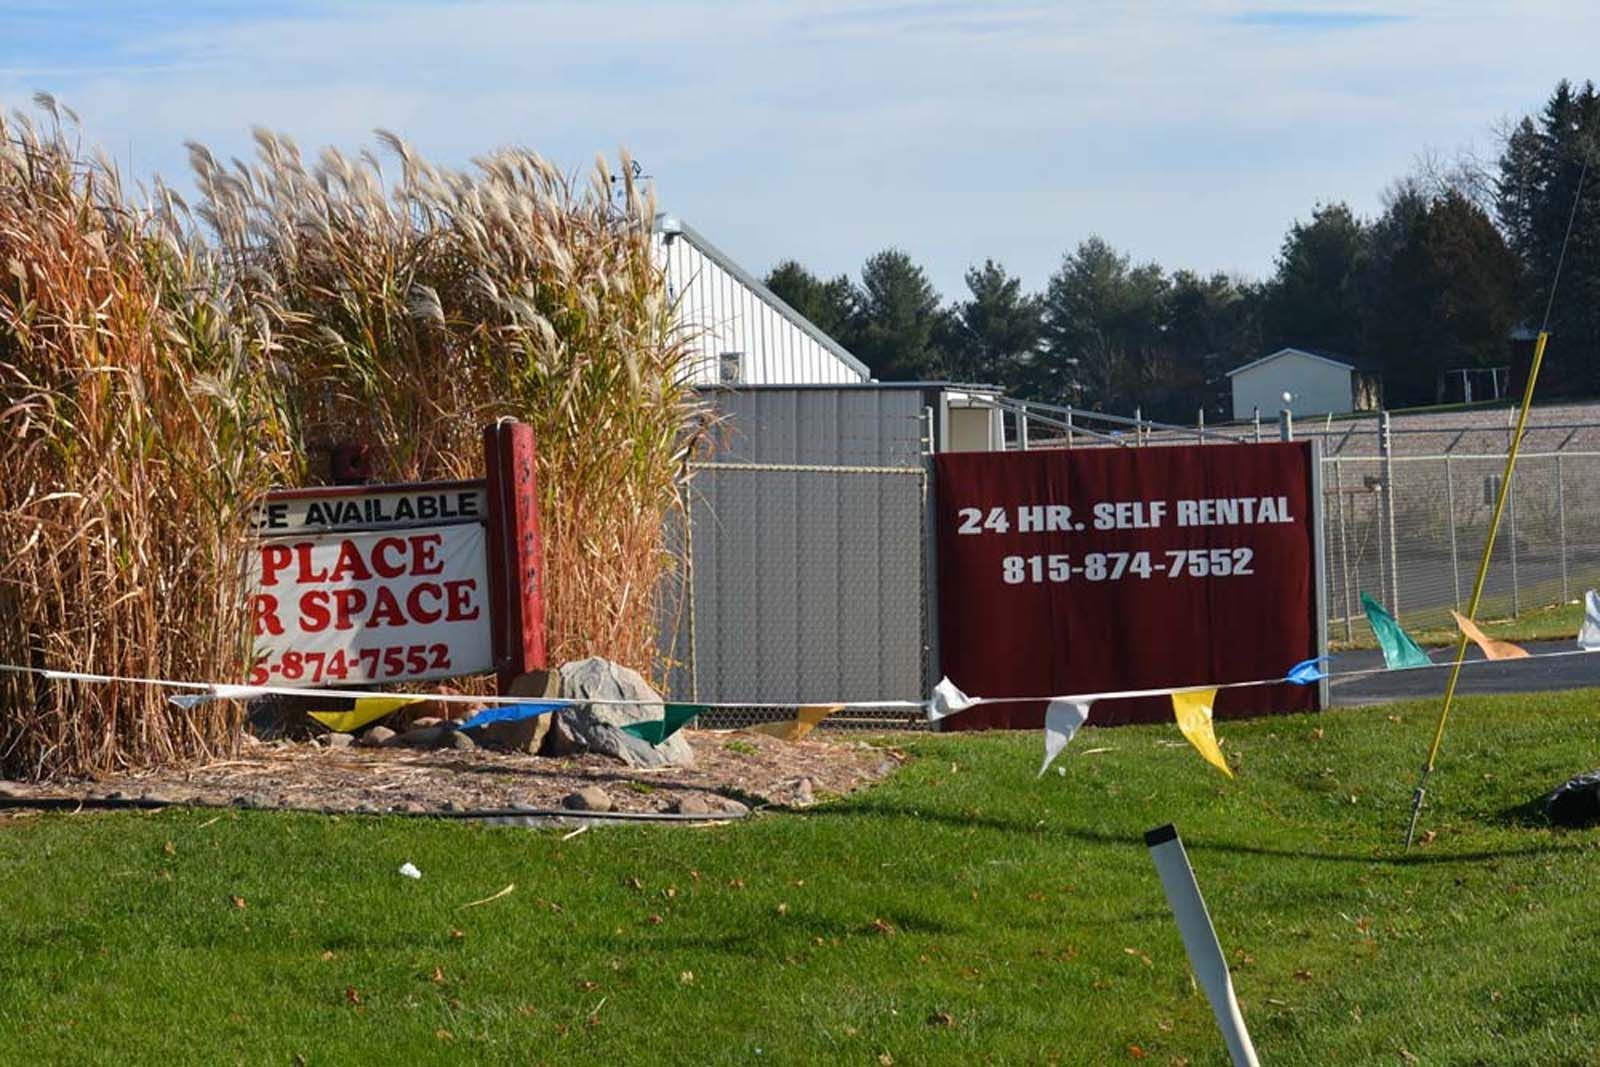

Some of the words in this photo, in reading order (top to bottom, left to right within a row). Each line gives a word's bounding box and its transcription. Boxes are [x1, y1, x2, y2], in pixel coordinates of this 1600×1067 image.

[305, 492, 479, 526] AVAILABLE
[957, 507, 1011, 534] 24
[1017, 504, 1086, 533] HR.
[1093, 501, 1167, 531] SELF
[1176, 496, 1295, 528] RENTAL
[259, 534, 445, 586] PLACE
[1002, 547, 1254, 584] 815-874-7552
[248, 593, 285, 636] R
[299, 578, 480, 633] SPACE
